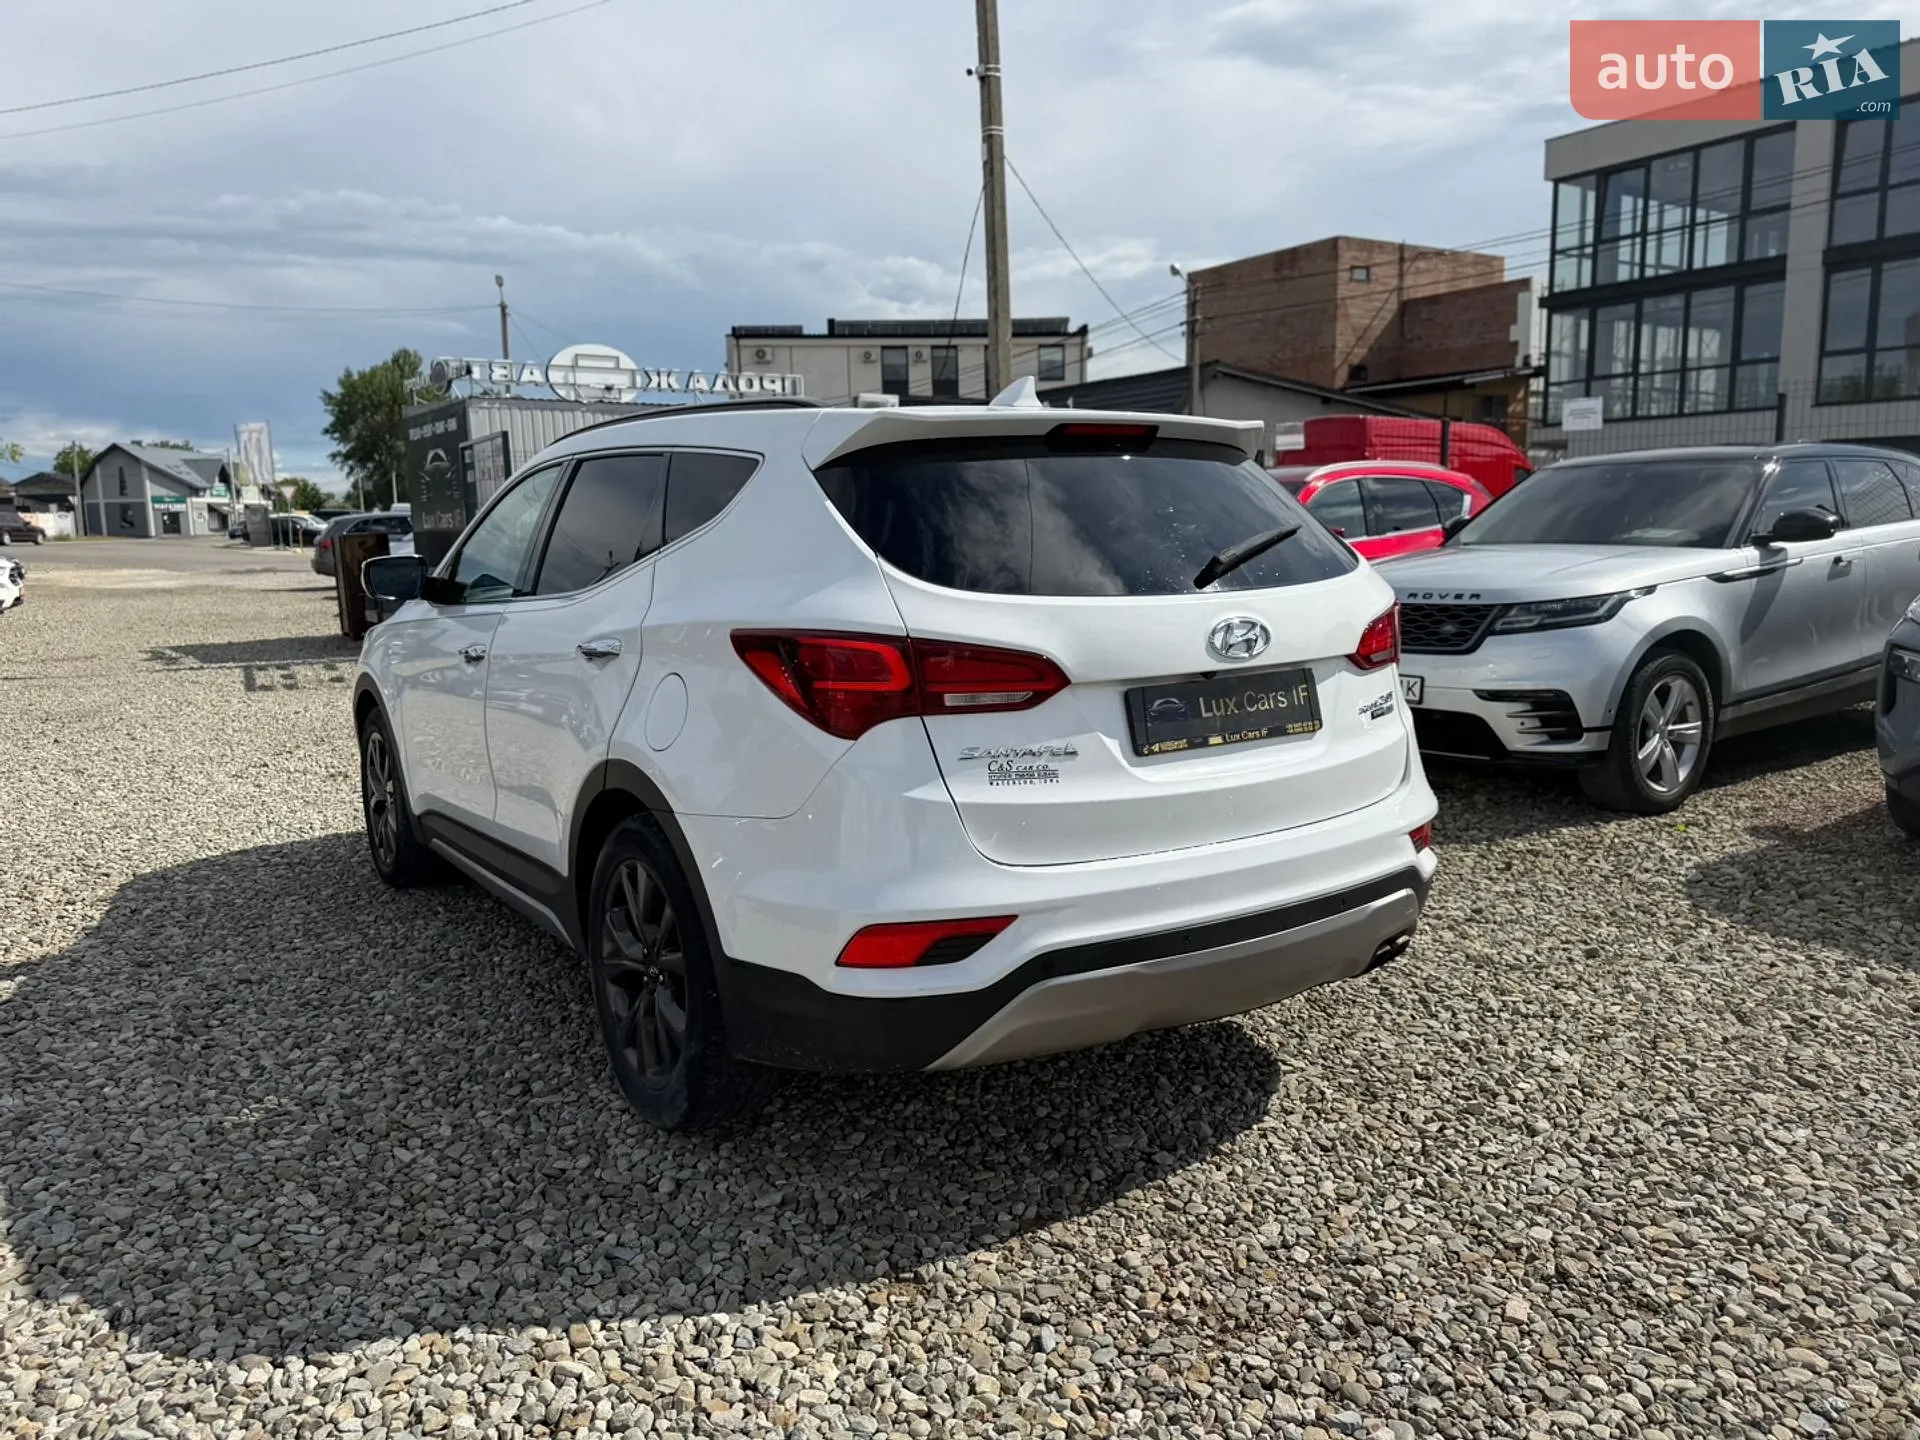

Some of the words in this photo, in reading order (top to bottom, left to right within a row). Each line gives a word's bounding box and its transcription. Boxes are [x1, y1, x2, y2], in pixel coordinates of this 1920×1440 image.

[1407, 592, 1481, 600] ROVER
[1199, 695, 1239, 718] Lux
[1244, 690, 1288, 712] Cars
[1292, 684, 1309, 706] IF
[1225, 732, 1240, 743] Lux
[1241, 730, 1260, 740] Cars
[988, 760, 1014, 772] C&S
